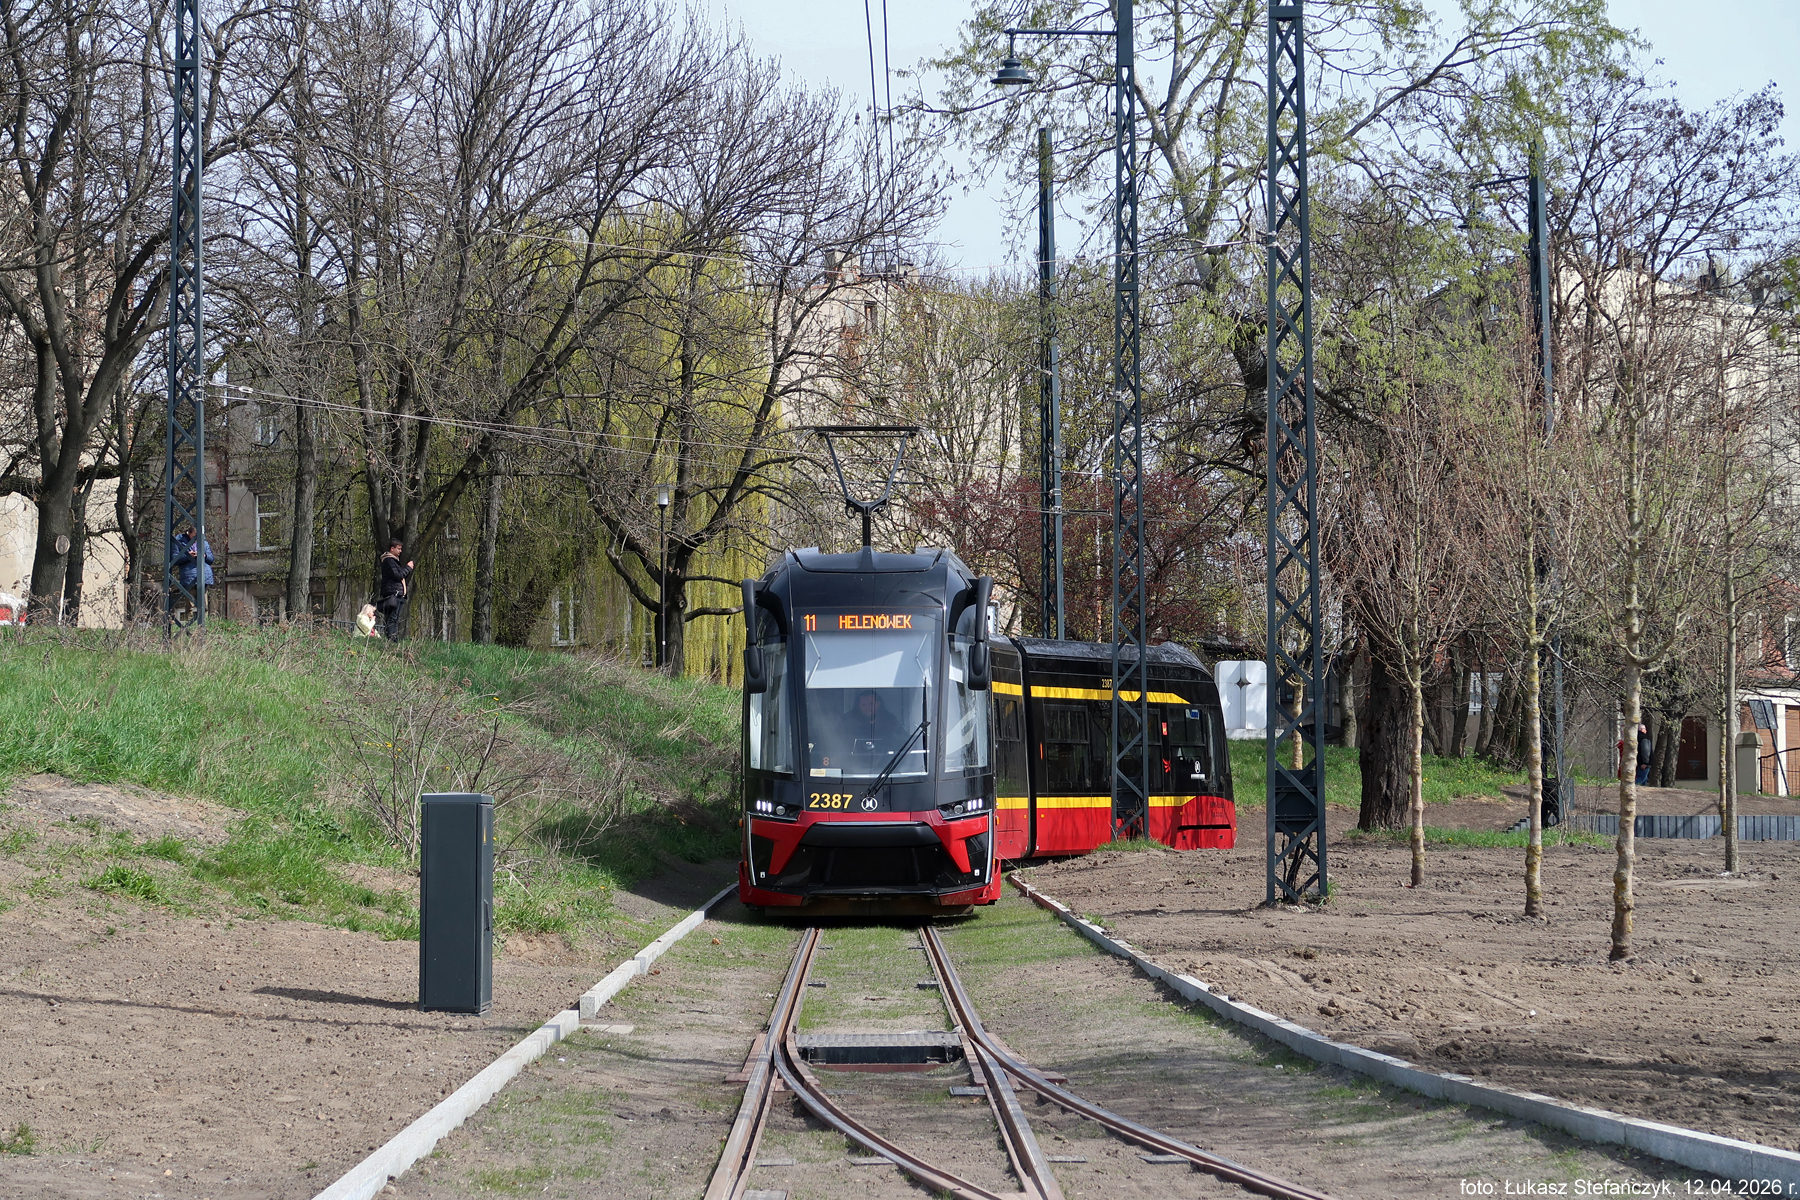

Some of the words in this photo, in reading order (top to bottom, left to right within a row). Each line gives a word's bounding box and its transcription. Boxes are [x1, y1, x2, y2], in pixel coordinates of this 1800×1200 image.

[803, 614, 817, 632] 11
[838, 614, 912, 629] HELENÓWEK
[809, 792, 853, 809] 2387
